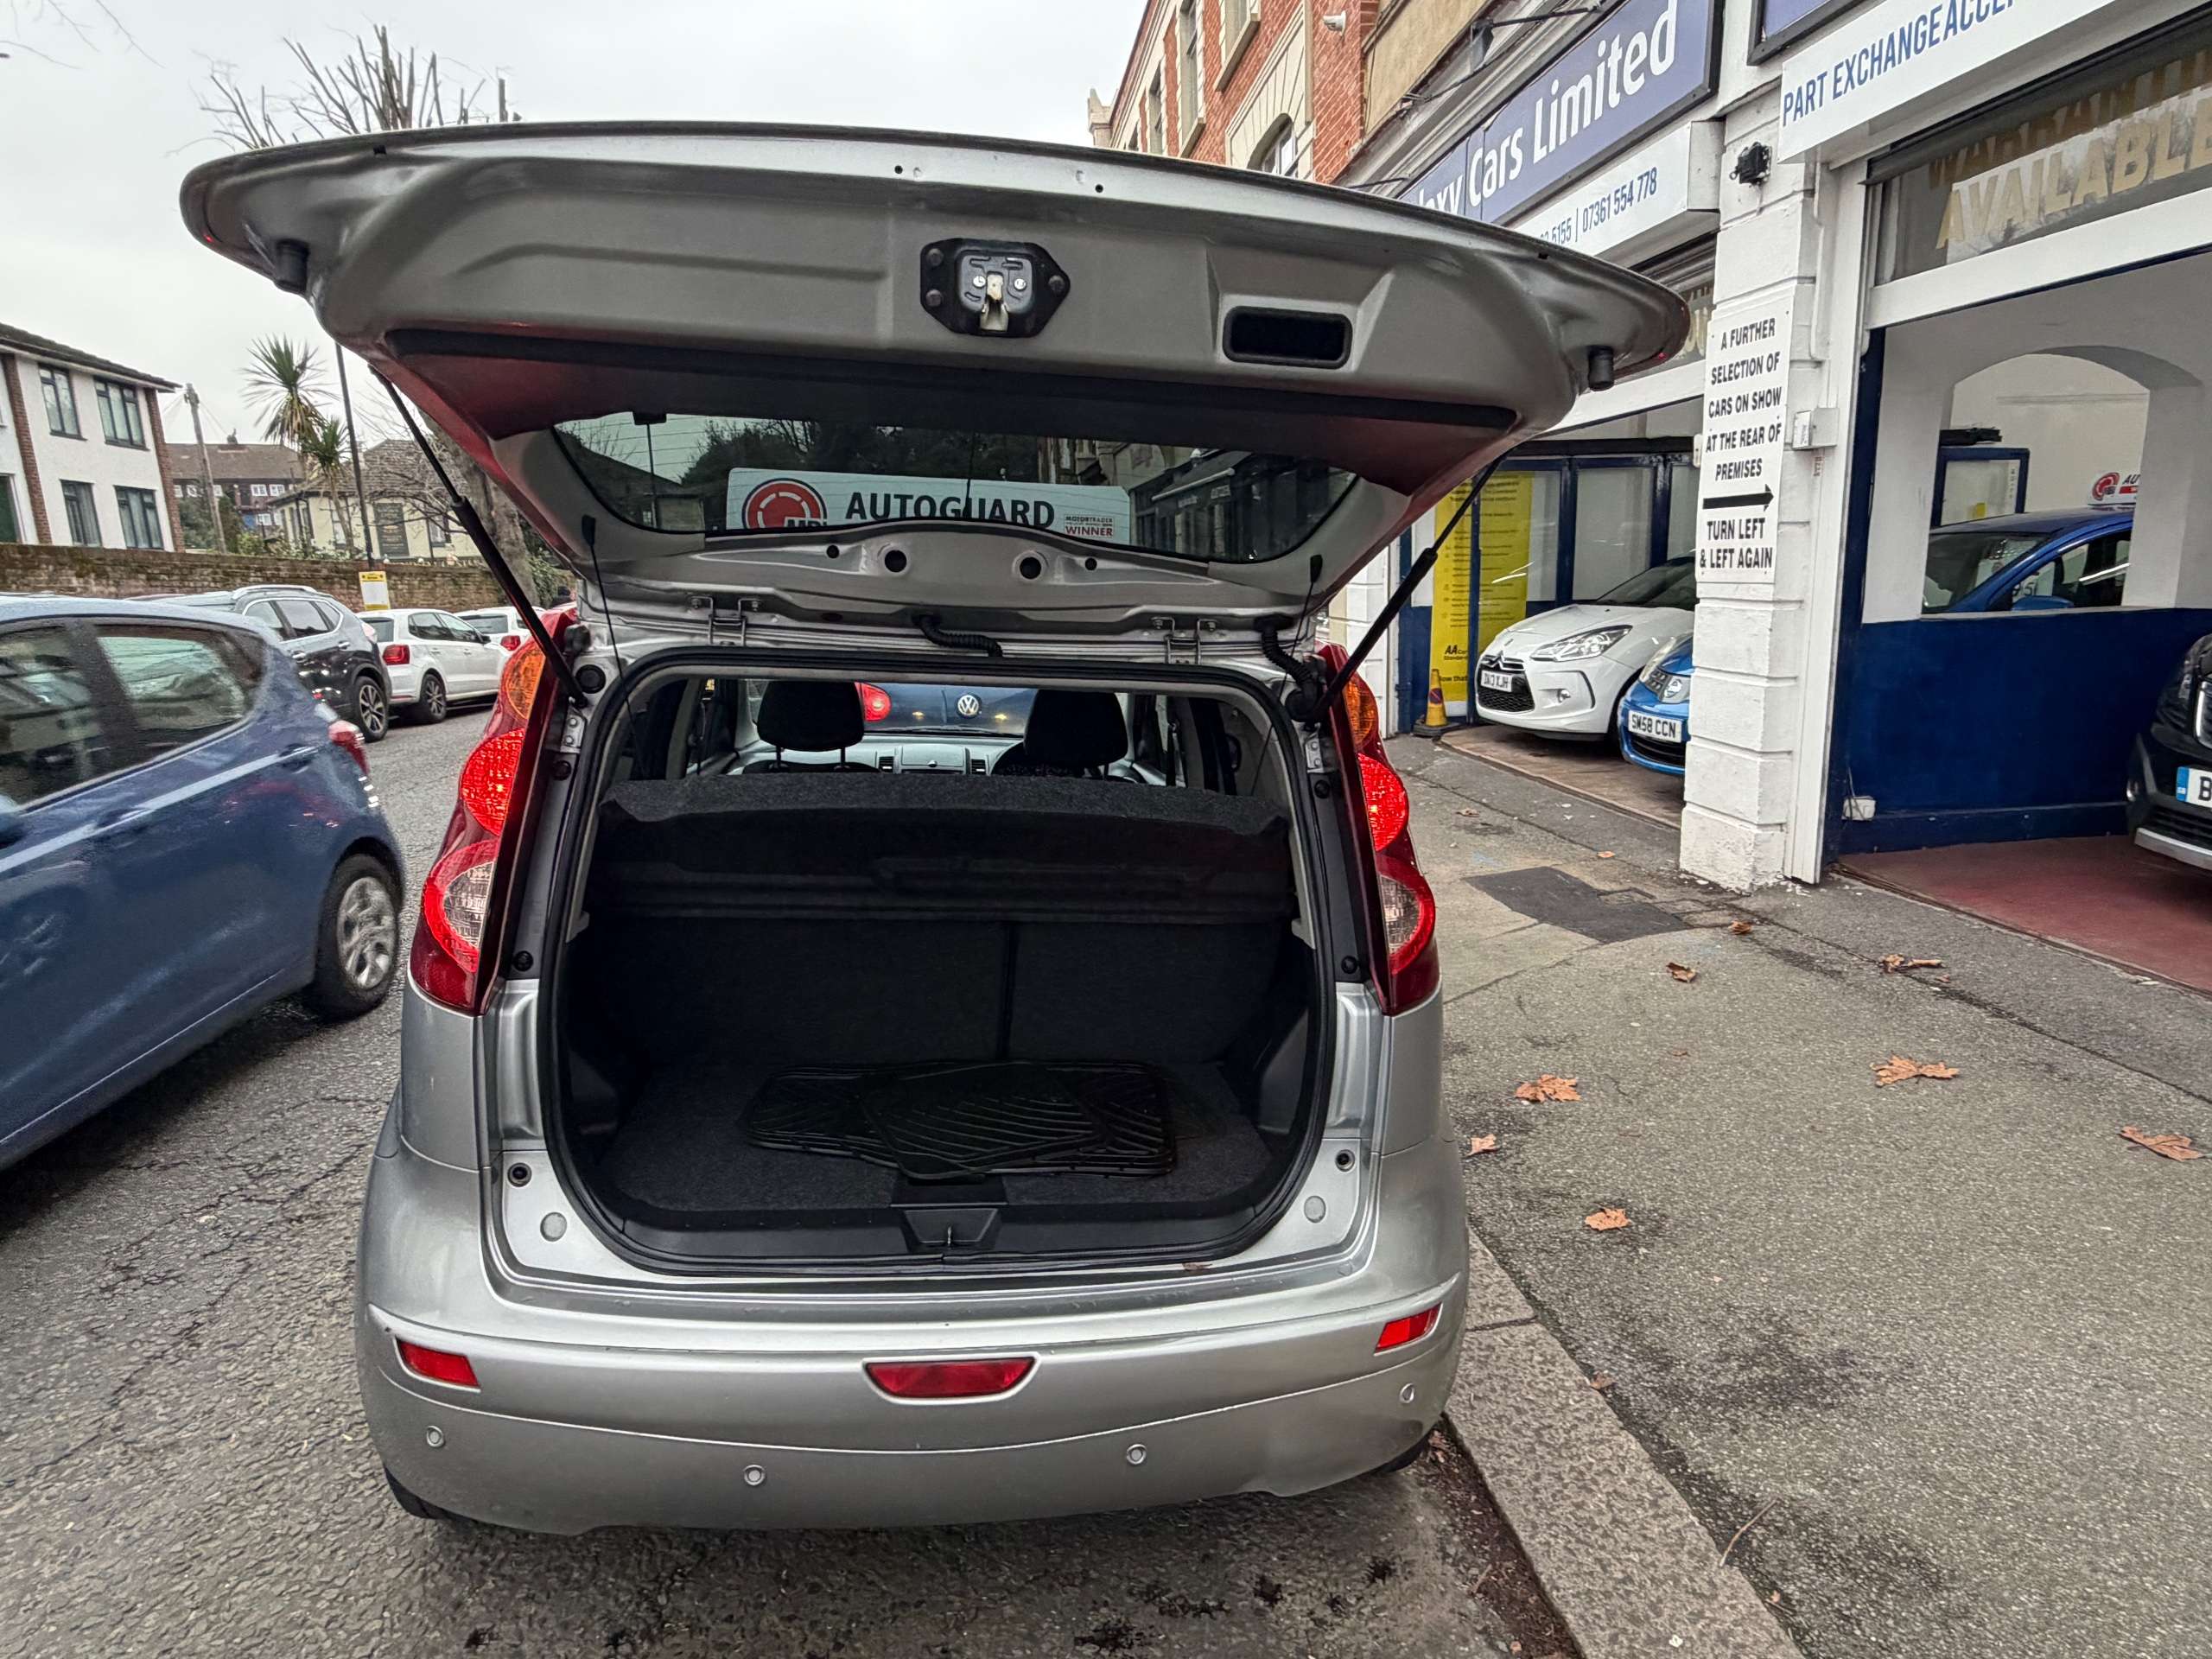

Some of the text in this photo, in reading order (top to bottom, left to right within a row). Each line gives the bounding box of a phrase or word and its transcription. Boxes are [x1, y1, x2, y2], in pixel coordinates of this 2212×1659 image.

[1470, 127, 1523, 207] Cars
[1533, 0, 1677, 164] Limited
[1783, 71, 1827, 127] PART
[1936, 95, 2212, 250] AVAILABLE
[1583, 193, 1611, 232] 07361
[1613, 180, 1634, 215] 554
[1637, 167, 1657, 202] 778
[1720, 332, 1727, 351] A
[1730, 318, 1776, 348] FURTHER
[1711, 351, 1781, 385] SELECTION OF
[1708, 386, 1782, 418] CARS ON SHOW
[1706, 434, 1718, 453] AT
[1719, 431, 1737, 450] THE
[1739, 426, 1765, 448] REAR
[1768, 423, 1782, 443] OF
[1715, 457, 1763, 481] PREMISES
[845, 492, 1055, 530] AUTOGUARD
[1065, 525, 1113, 536] WINNER
[1707, 518, 1765, 541] TURN LEFT
[1700, 547, 1772, 569] & LEFT AGAIN
[1655, 719, 1676, 739] CCN
